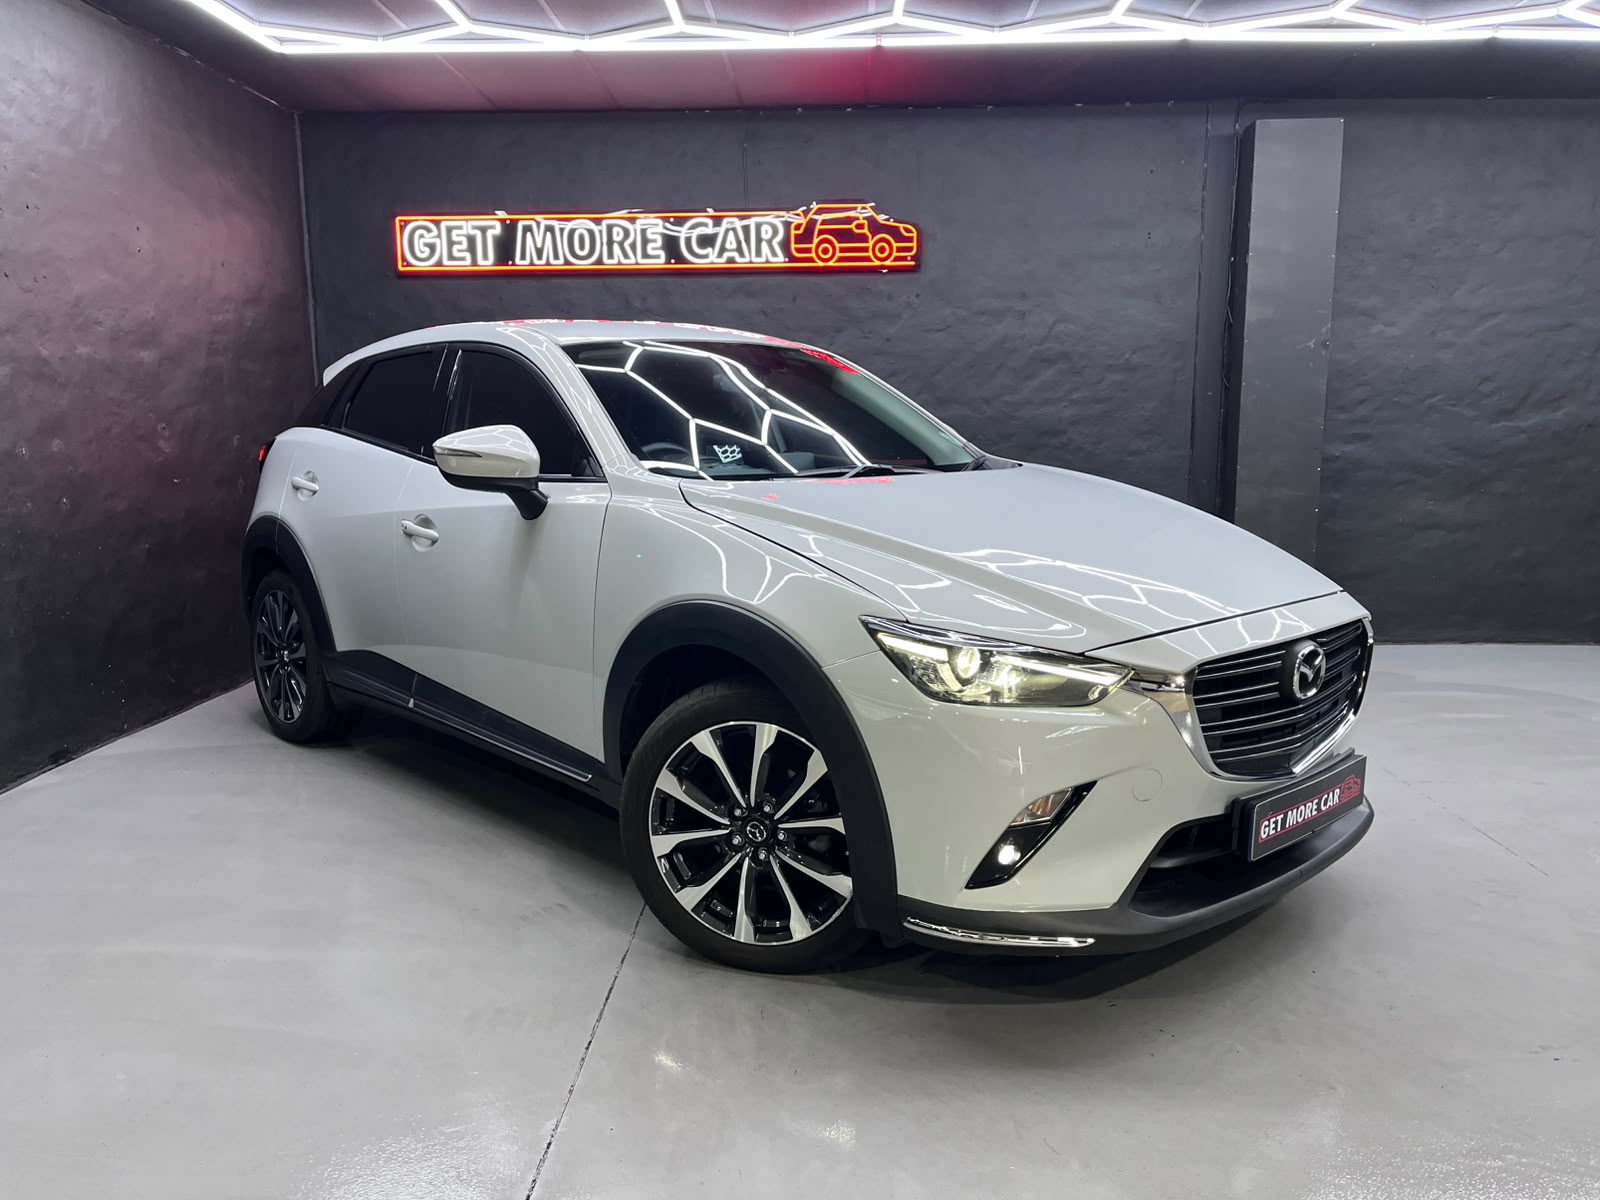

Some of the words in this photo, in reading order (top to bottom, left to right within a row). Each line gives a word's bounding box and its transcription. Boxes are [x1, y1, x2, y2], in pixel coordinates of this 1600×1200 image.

[402, 220, 500, 267] GET
[515, 217, 666, 264] MORE
[680, 216, 785, 264] CAR
[1260, 814, 1284, 839] GET
[1285, 799, 1318, 828] MORE
[1321, 789, 1340, 811] CAR
